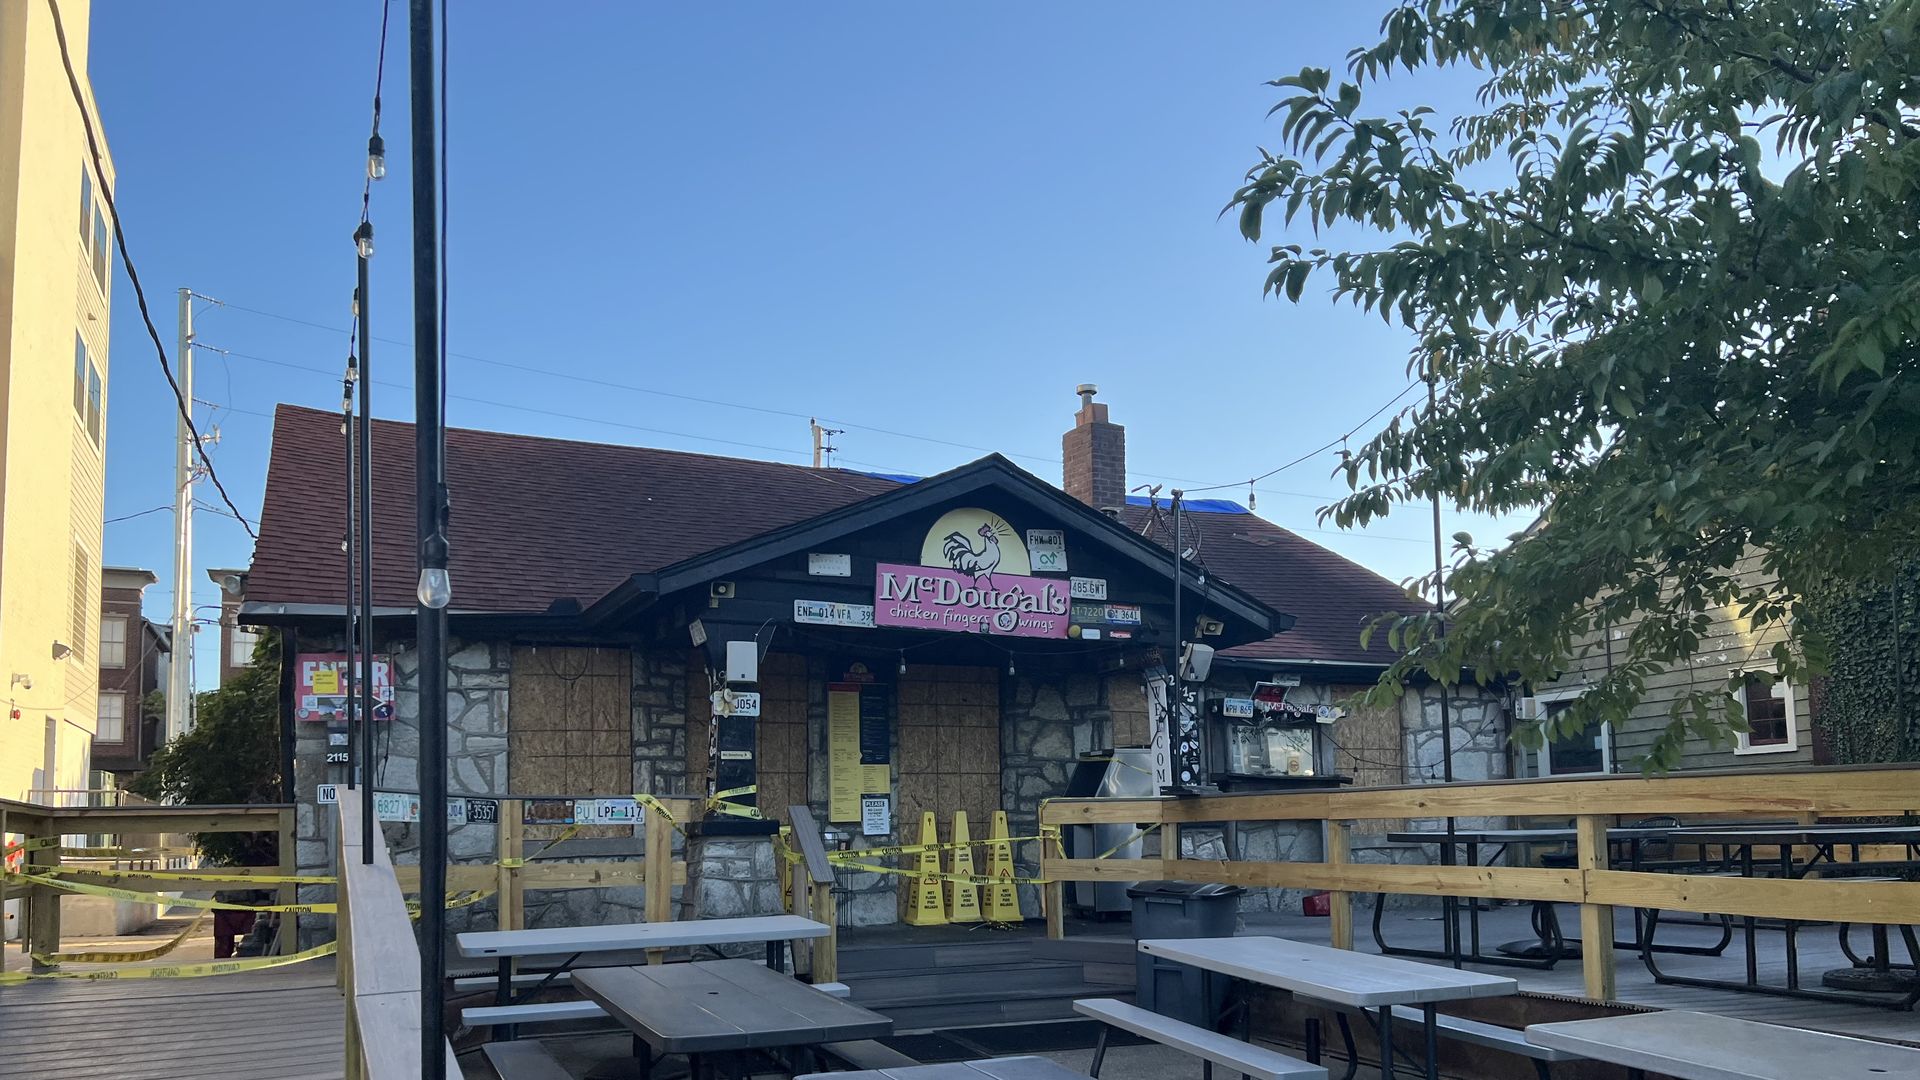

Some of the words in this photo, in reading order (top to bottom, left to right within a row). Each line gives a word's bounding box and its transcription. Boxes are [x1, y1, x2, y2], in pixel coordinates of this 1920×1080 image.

[880, 572, 1067, 631] McDougal's
[889, 603, 940, 621] chicken
[942, 608, 989, 626] fingers
[1018, 615, 1054, 632] wings
[1168, 674, 1197, 703] 215
[1153, 685, 1166, 784] WELCOM
[326, 752, 349, 762] 2115
[322, 787, 336, 799] NO
[597, 805, 616, 818] LPF
[623, 805, 643, 818] 117
